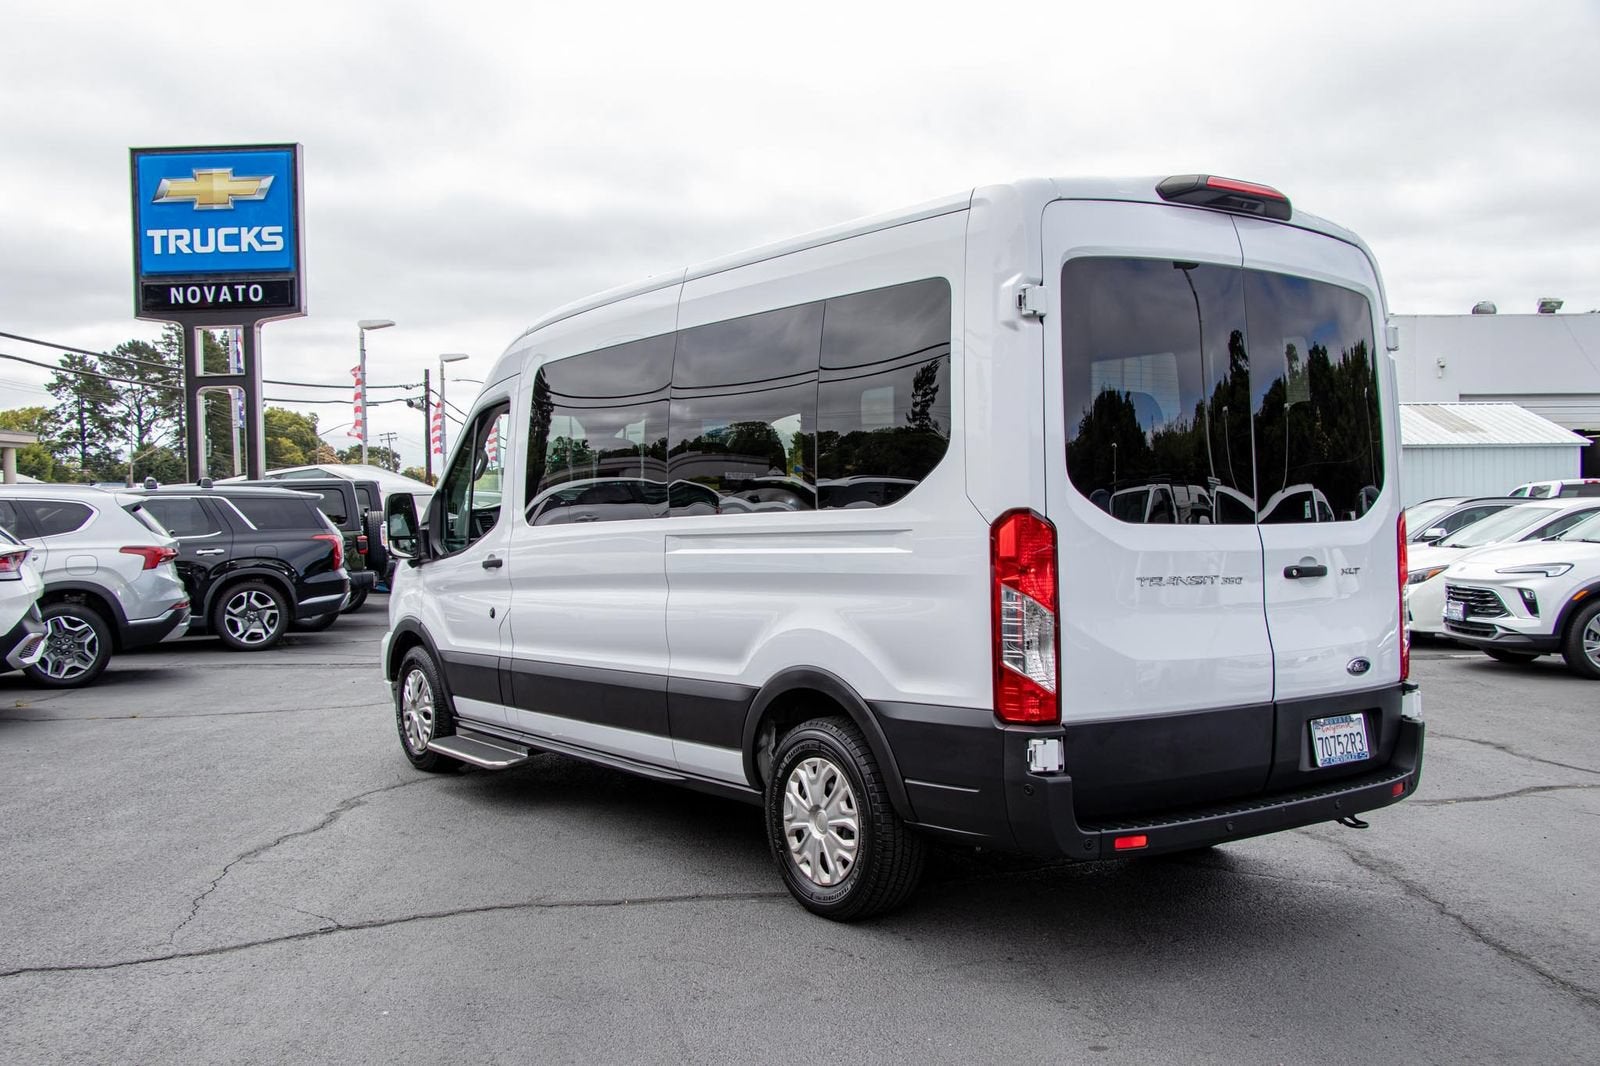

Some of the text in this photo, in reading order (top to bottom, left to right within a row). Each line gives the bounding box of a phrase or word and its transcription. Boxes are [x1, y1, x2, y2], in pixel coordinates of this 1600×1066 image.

[147, 226, 284, 255] TRUCKS
[170, 284, 263, 304] NOVATO
[1136, 575, 1219, 587] TRANSIT
[1341, 567, 1361, 576] XLT
[1317, 732, 1364, 759] 70752R3
